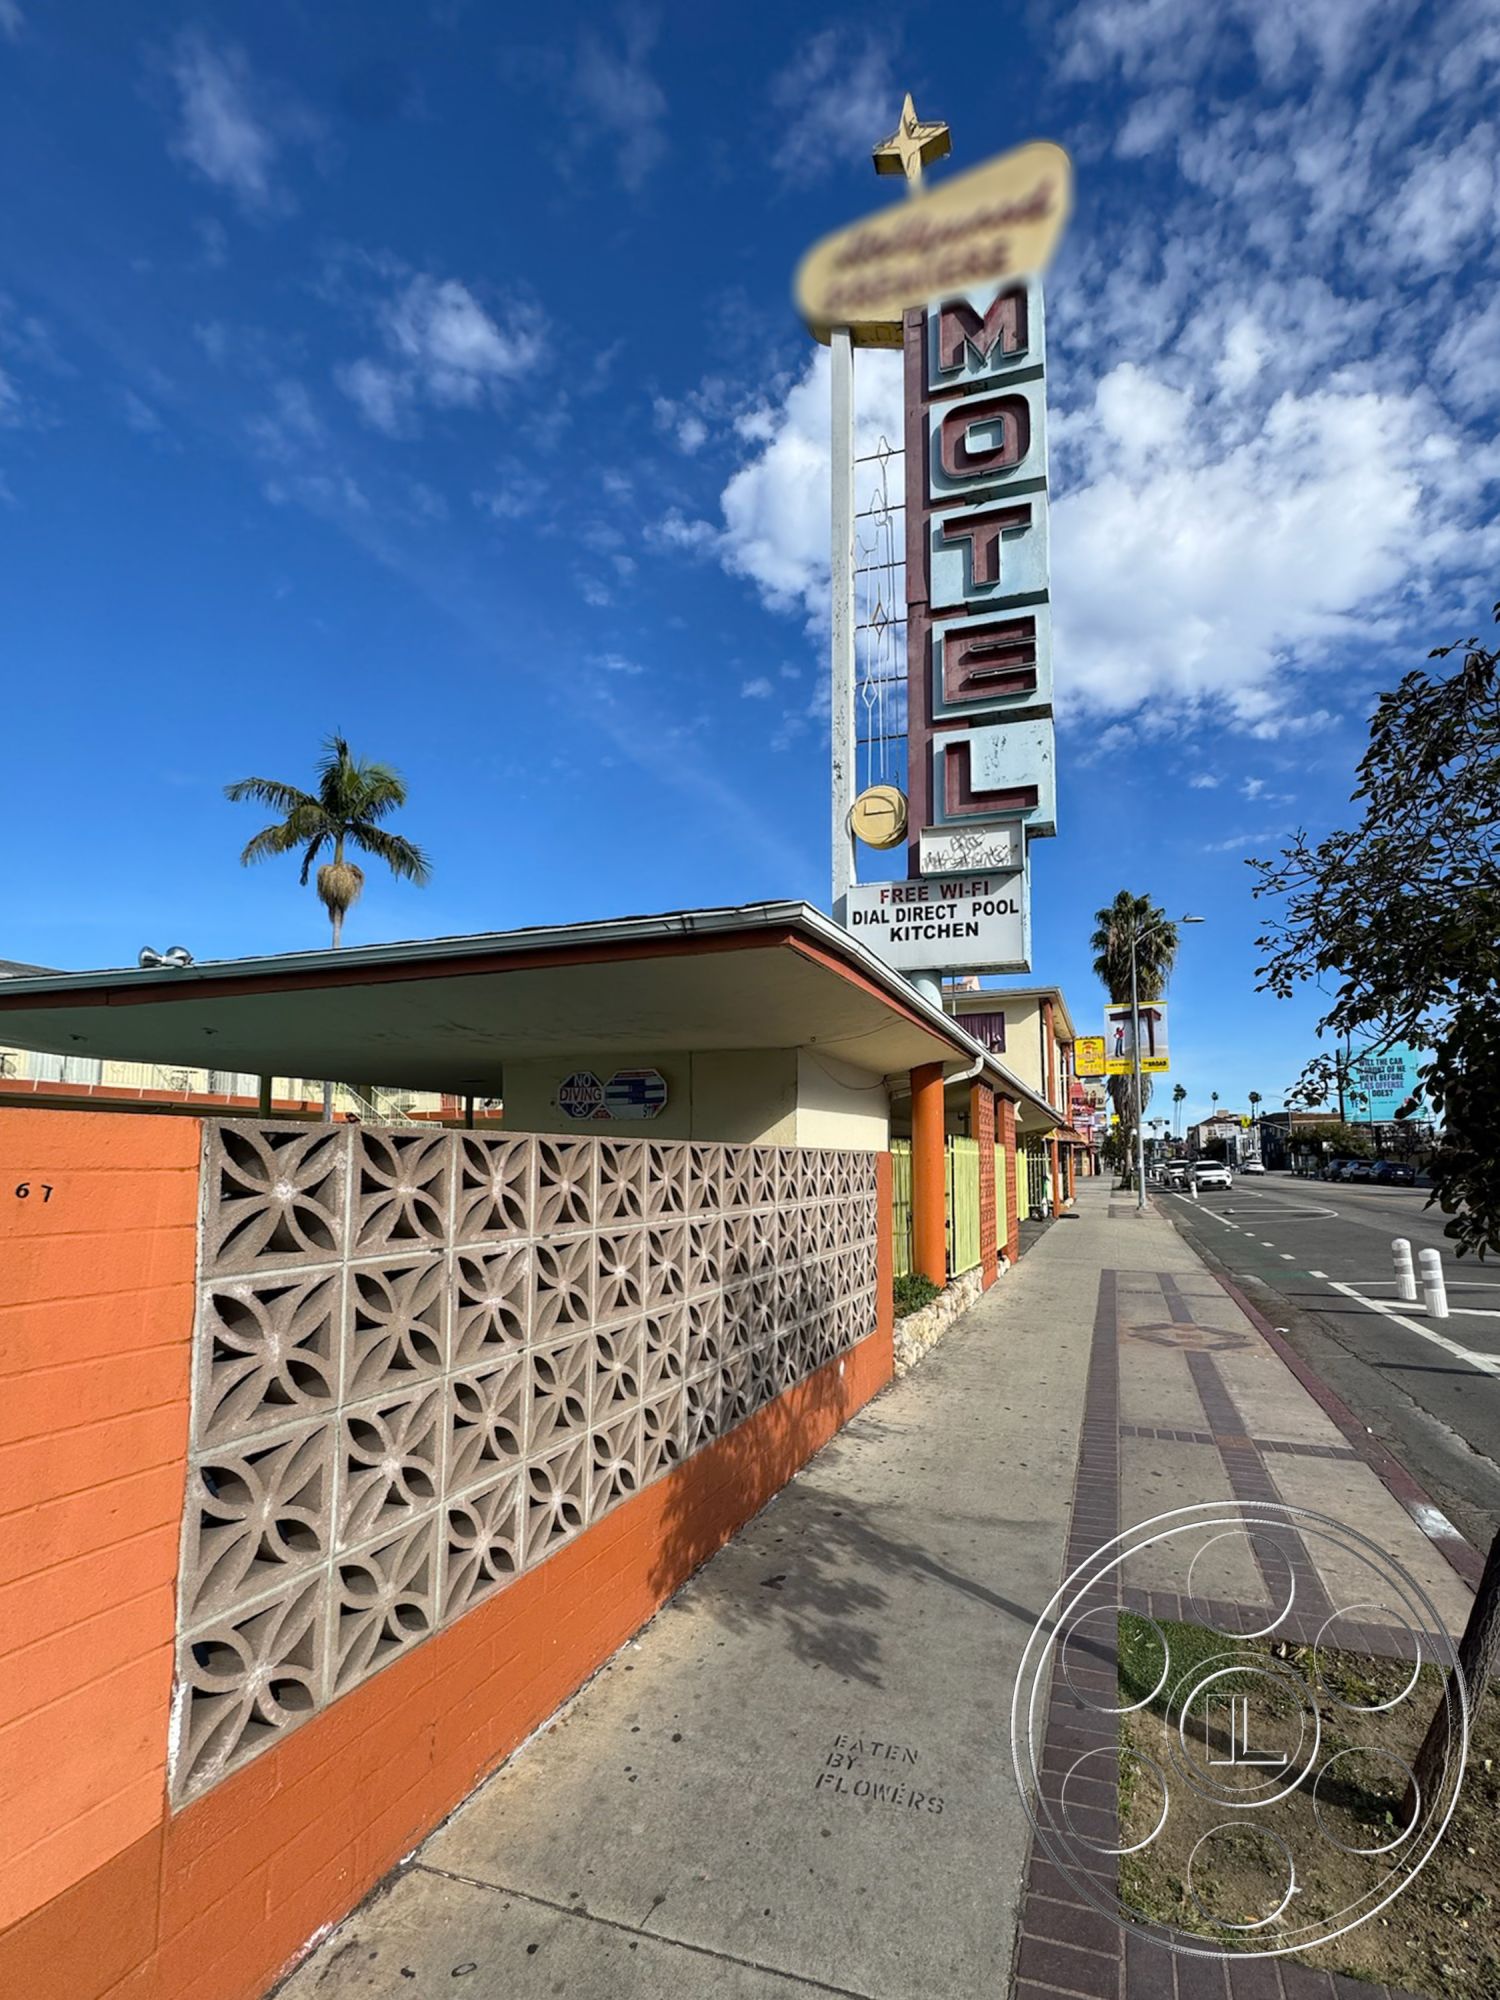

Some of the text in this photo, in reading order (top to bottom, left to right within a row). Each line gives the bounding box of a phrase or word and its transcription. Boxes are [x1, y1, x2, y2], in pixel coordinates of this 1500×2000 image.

[939, 281, 1038, 818] MOTEL
[880, 881, 989, 904] FREE WI-FI
[852, 899, 1019, 925] DIAL DIRECT POOL
[890, 922, 979, 942] KITCHEN
[1389, 1057, 1402, 1065] CAR
[573, 1076, 592, 1087] NO
[1379, 1073, 1404, 1081] BEFORE
[560, 1087, 602, 1101] DIVING
[1372, 1089, 1393, 1097] DOES?
[834, 1734, 919, 1765] EATEN
[825, 1752, 858, 1770] BY
[815, 1773, 944, 1814] FLOWERS
